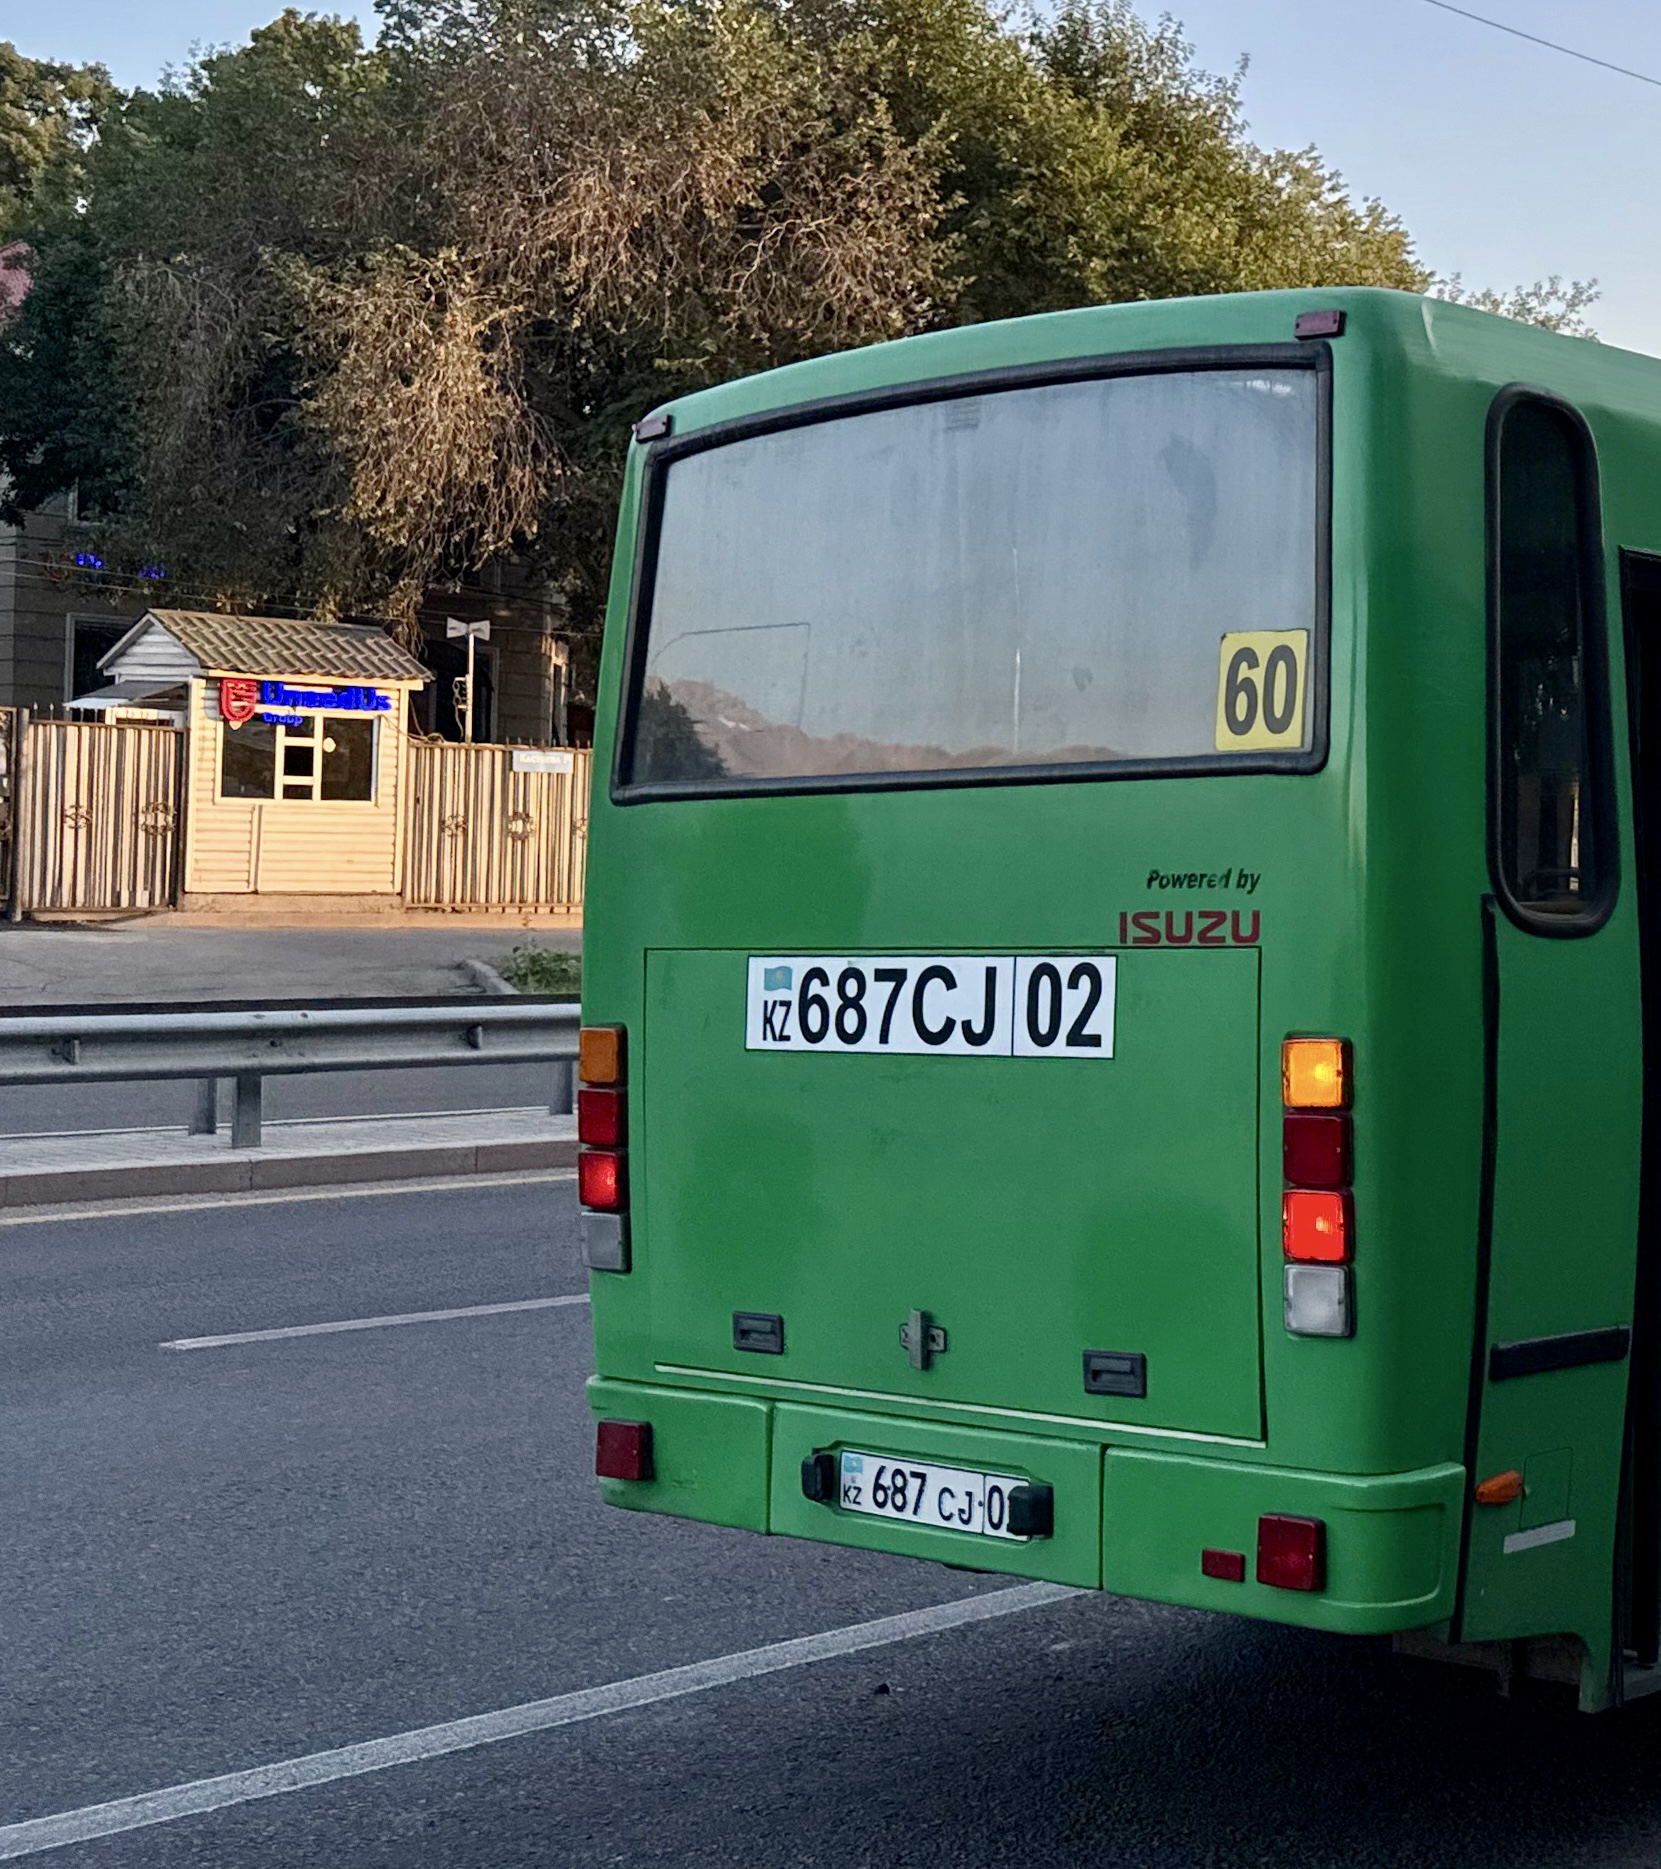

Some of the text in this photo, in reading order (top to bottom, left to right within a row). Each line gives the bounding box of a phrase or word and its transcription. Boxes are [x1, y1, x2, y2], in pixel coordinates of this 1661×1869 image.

[1224, 644, 1298, 736] 60
[262, 712, 304, 727] Group
[1147, 868, 1261, 894] Powered by
[1119, 910, 1260, 944] ISUZU
[763, 962, 1102, 1048] KZ 687CJ 02
[843, 1465, 1004, 1531] KZ 687 CJ 0
